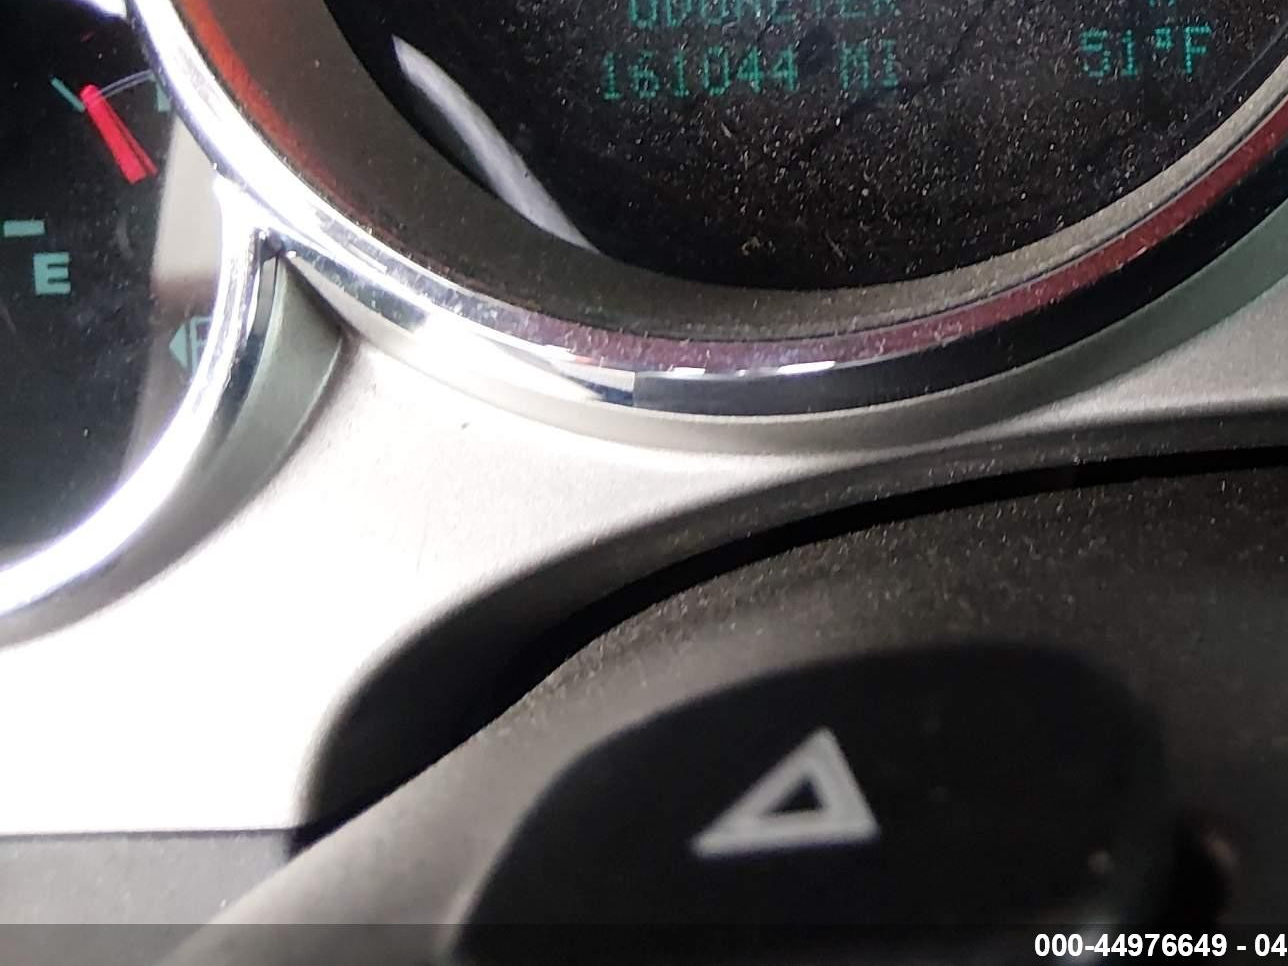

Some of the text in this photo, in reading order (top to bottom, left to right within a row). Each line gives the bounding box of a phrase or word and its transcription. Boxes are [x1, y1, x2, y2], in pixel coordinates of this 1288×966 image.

[603, 38, 899, 100] 161044 MI
[33, 252, 72, 296] E
